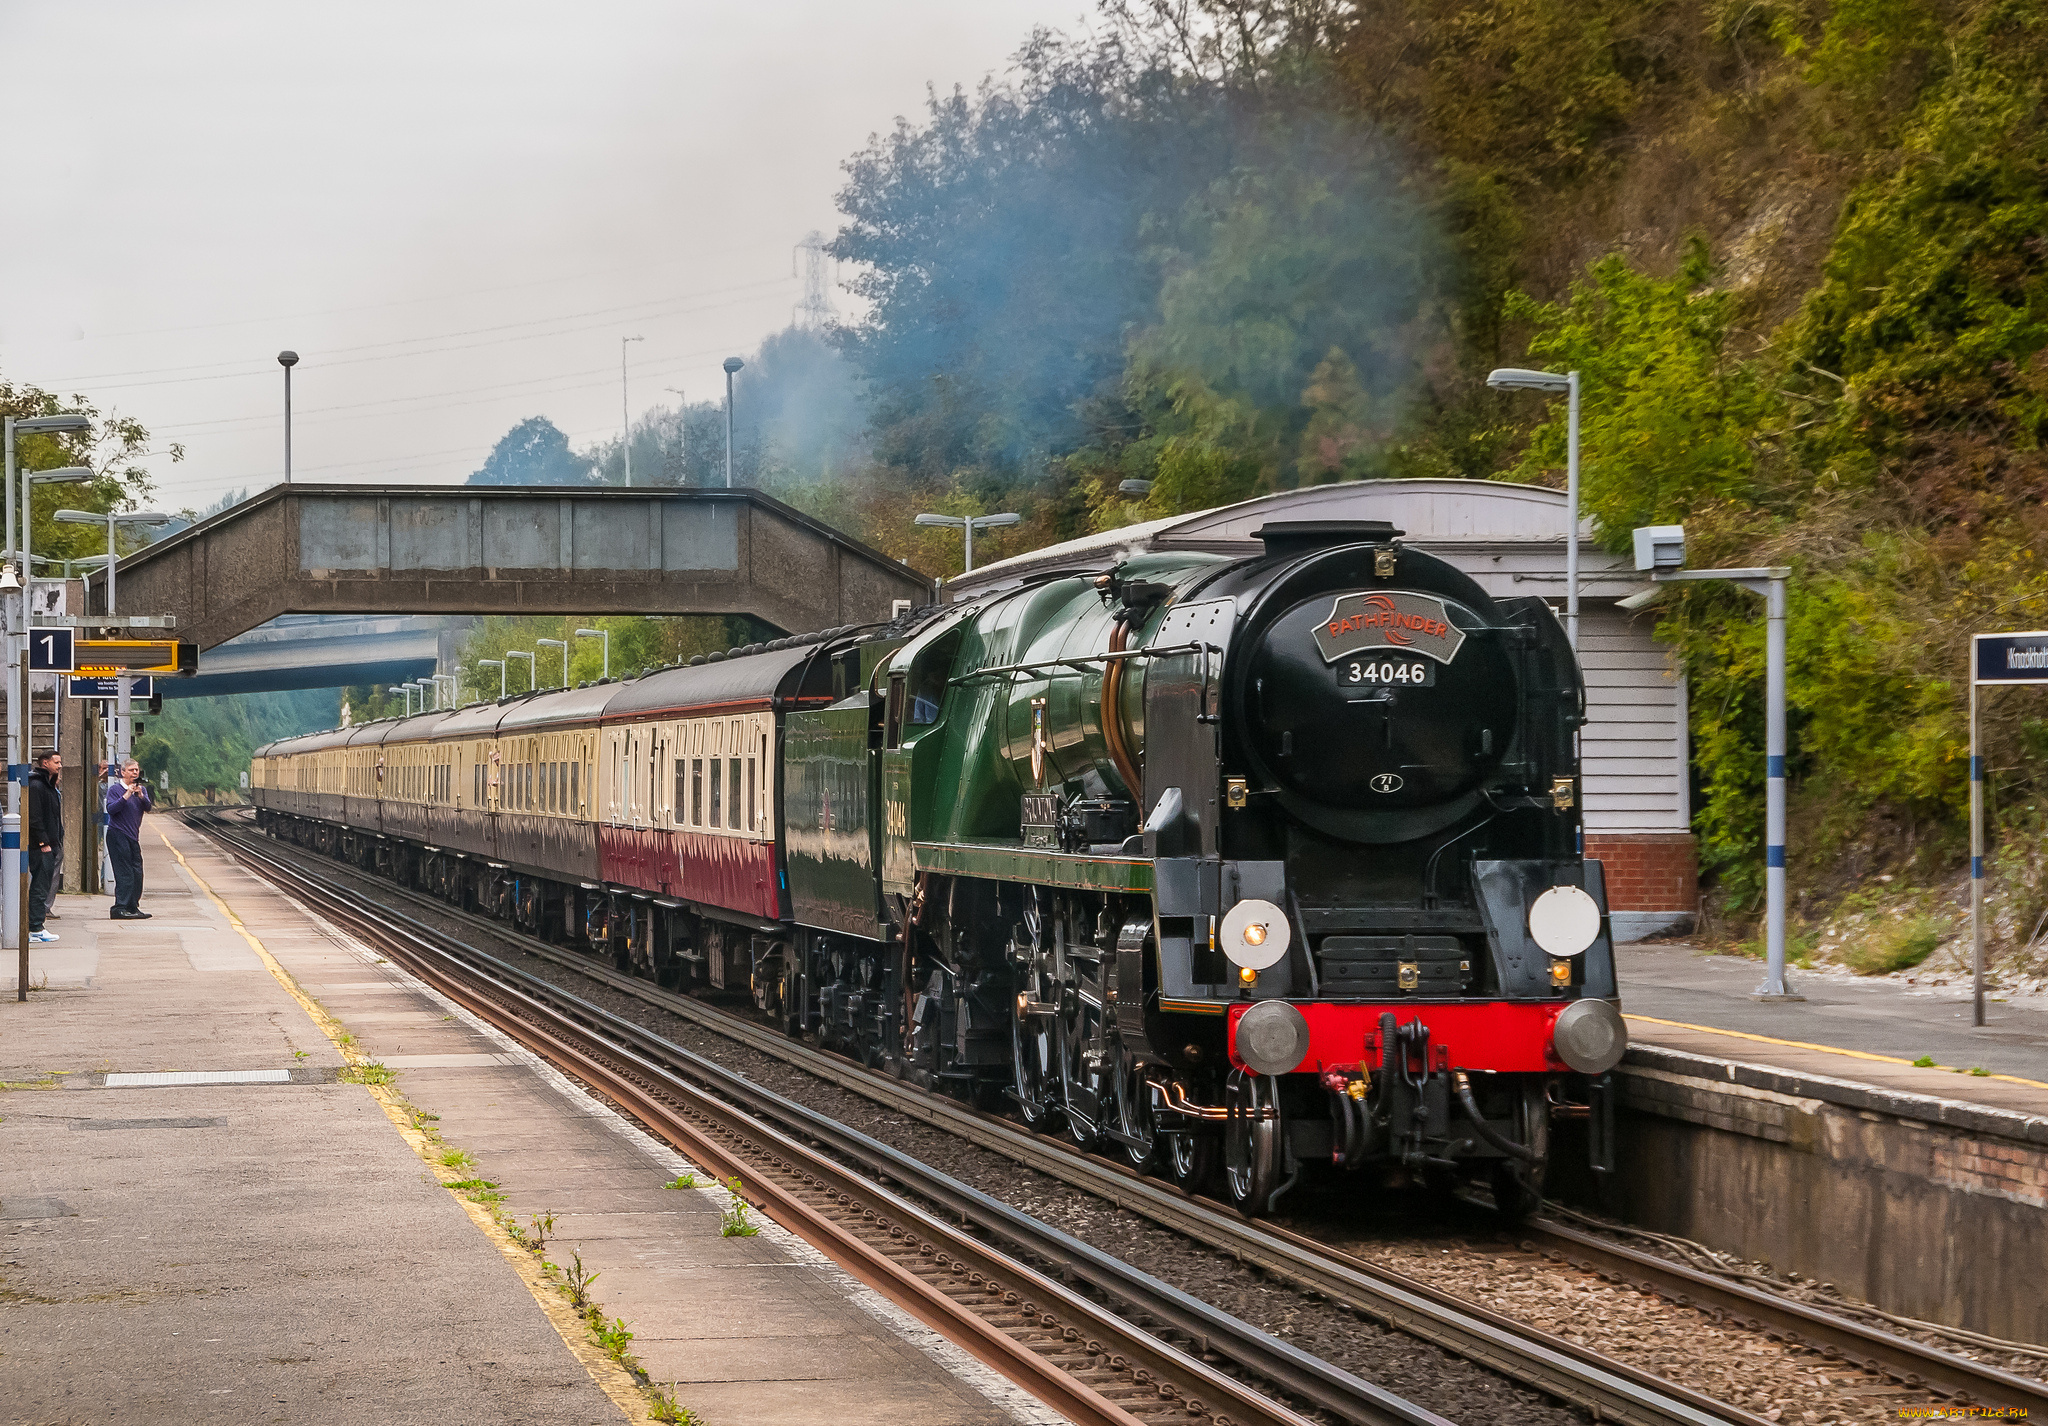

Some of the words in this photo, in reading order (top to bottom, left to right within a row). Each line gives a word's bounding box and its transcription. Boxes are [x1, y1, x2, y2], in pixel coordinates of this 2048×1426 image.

[1328, 611, 1448, 639] PATHFINDER
[39, 635, 54, 665] 1
[1349, 662, 1426, 684] 34046
[1381, 776, 1392, 785] 71
[886, 798, 906, 838] 34046
